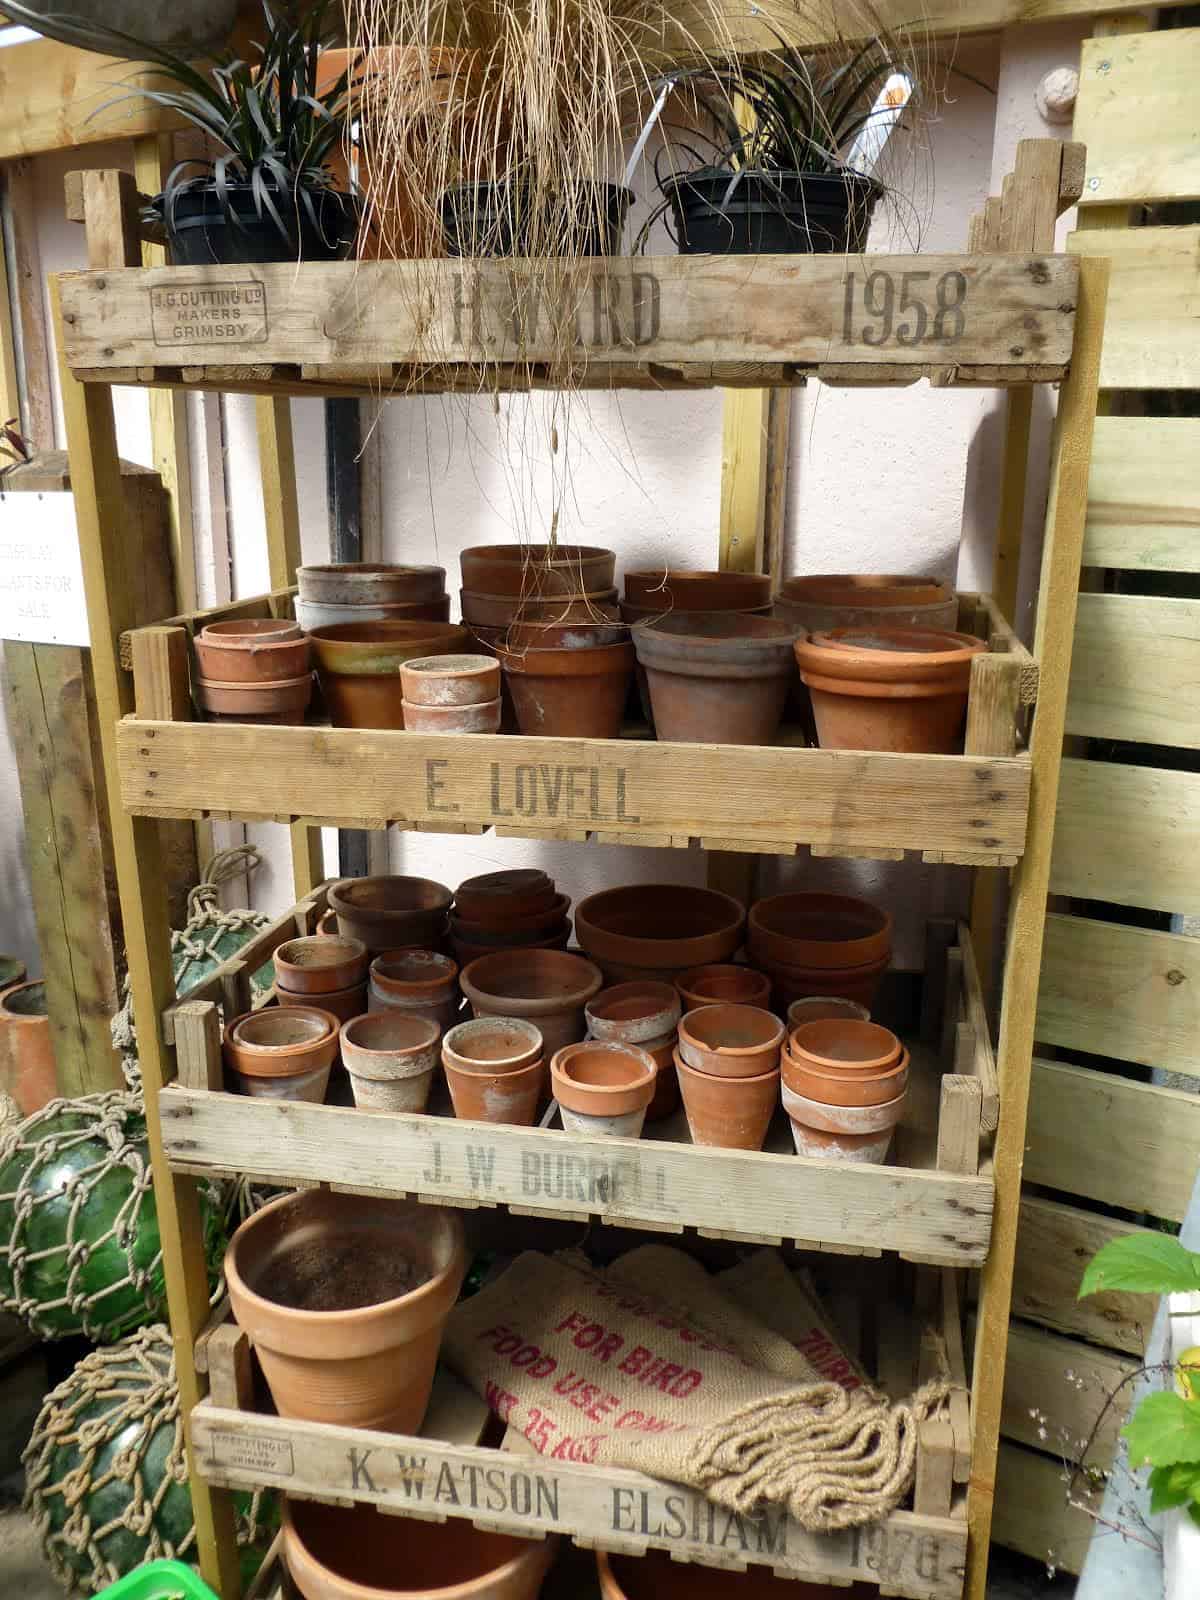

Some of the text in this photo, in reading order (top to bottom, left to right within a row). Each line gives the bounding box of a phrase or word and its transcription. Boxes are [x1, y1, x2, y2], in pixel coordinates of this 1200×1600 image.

[172, 323, 248, 339] GRIMSBY
[177, 308, 241, 321] MAKERS
[842, 270, 968, 346] 1958
[426, 759, 641, 823] E. LOVELL
[475, 1325, 559, 1380] FOOD
[552, 1371, 622, 1425] USE
[553, 1311, 625, 1364] FOR
[617, 1344, 703, 1399] BIRD
[524, 1408, 558, 1455] 25
[347, 1447, 389, 1494] K.
[398, 1453, 559, 1521] WATSON
[612, 1486, 789, 1555] ELSHAM
